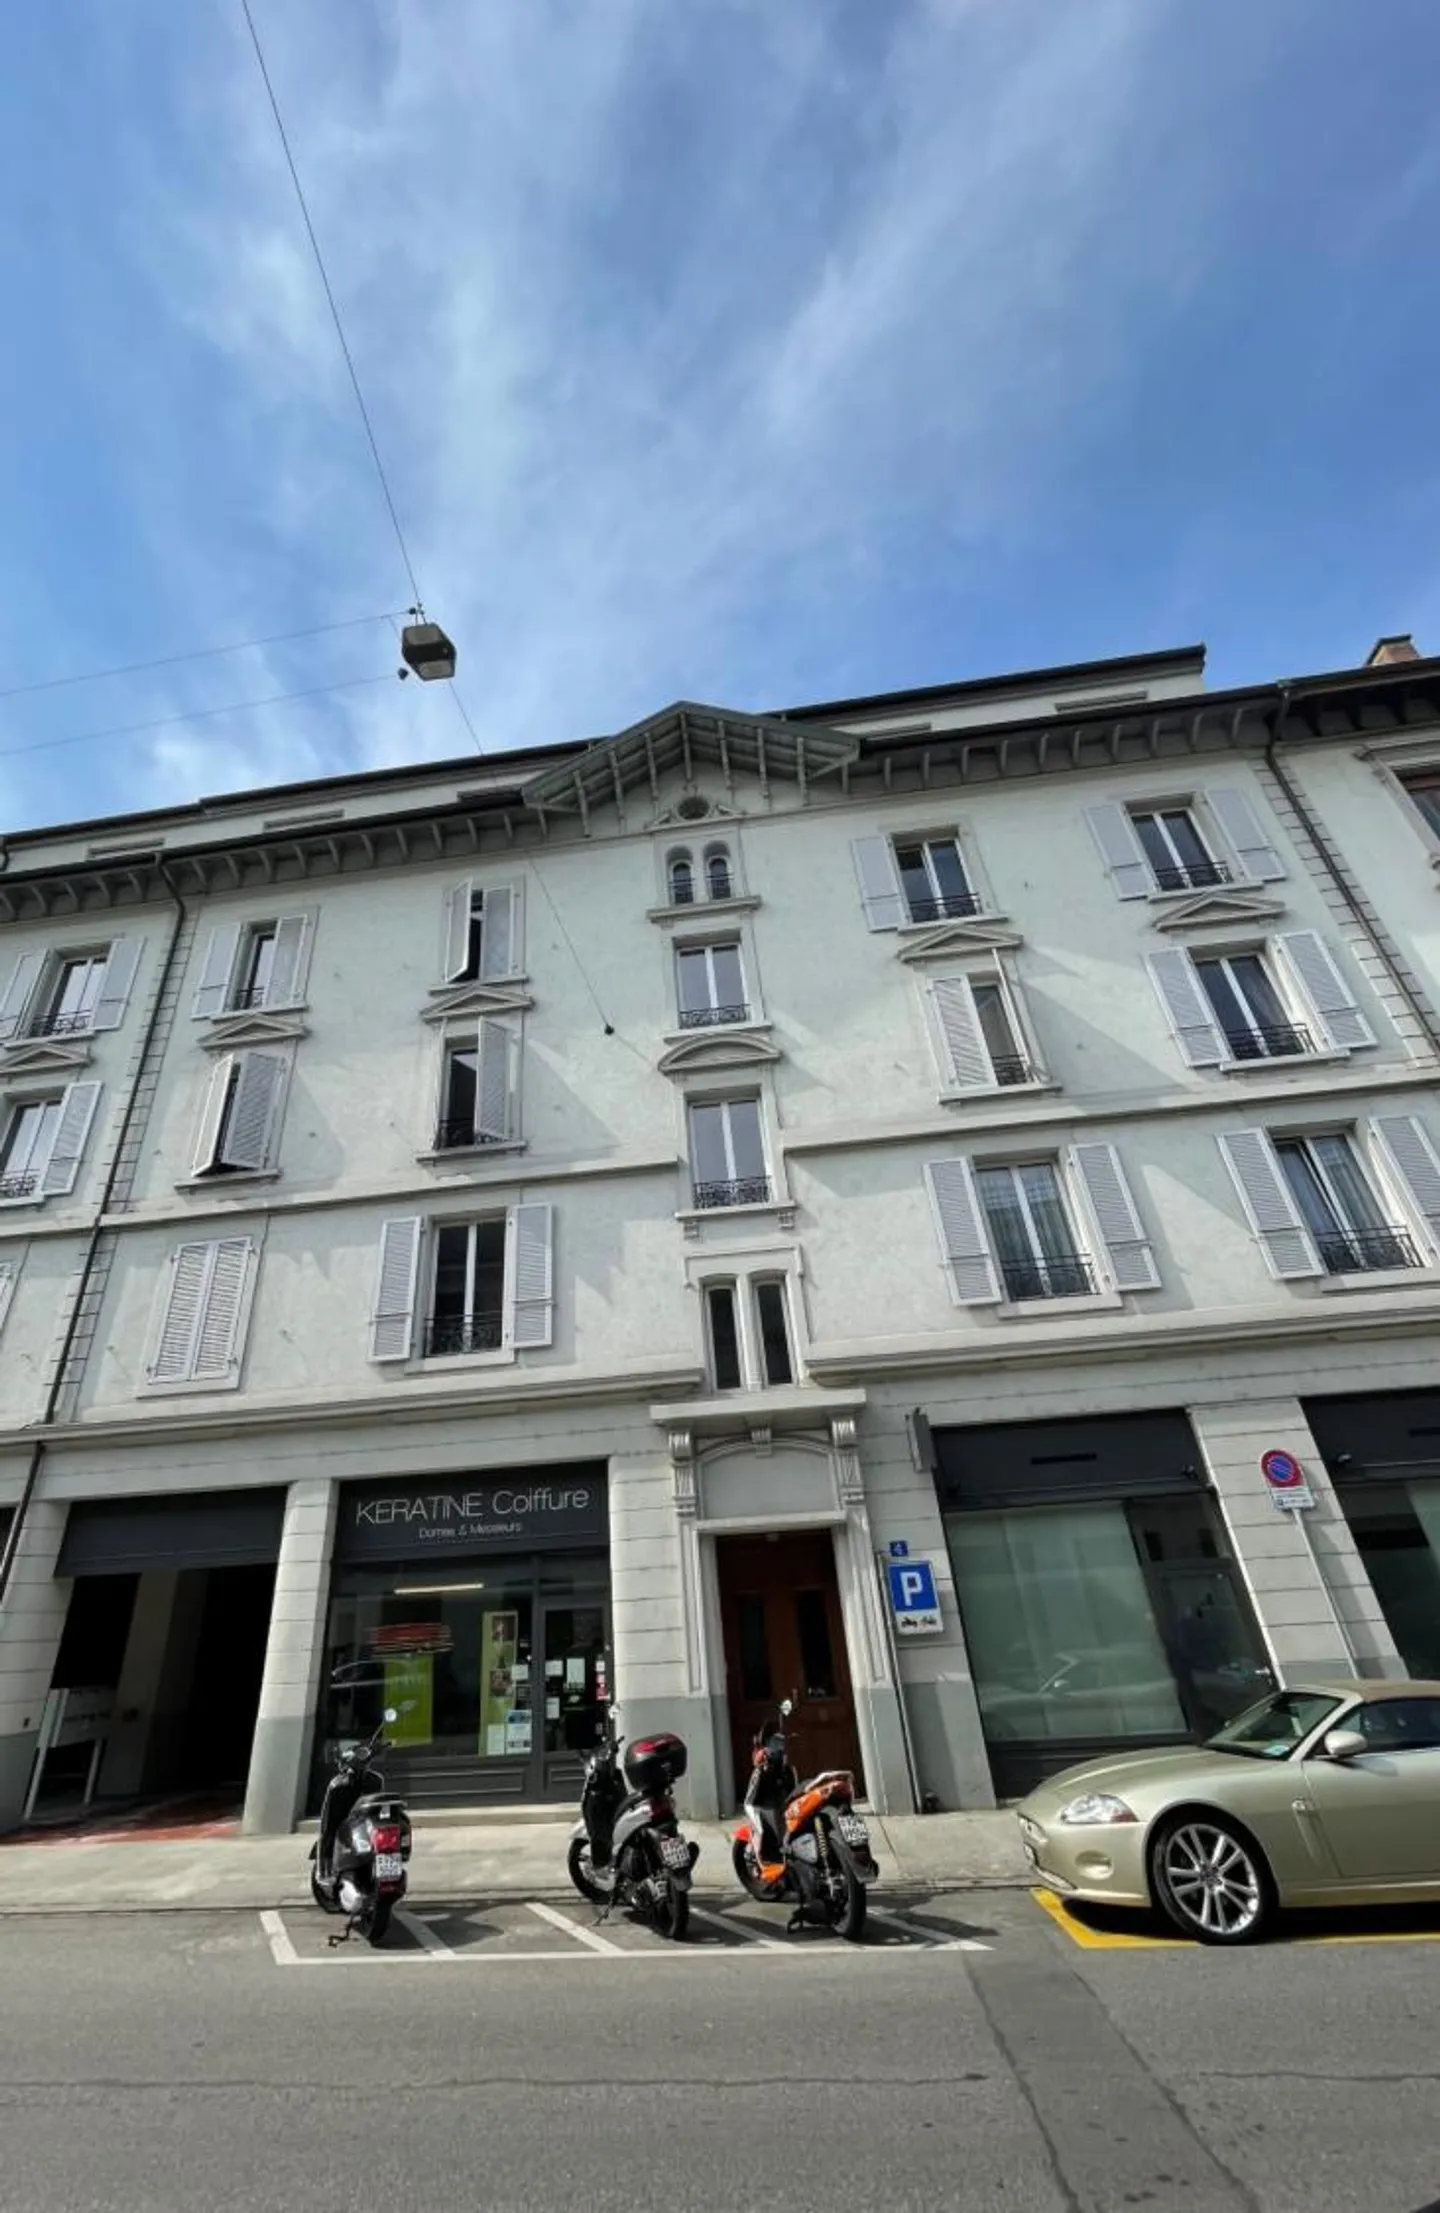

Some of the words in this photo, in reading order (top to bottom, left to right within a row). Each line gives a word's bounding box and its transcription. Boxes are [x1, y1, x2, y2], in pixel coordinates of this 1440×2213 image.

[356, 1492, 484, 1525] KERATINE
[492, 1487, 590, 1515] Coiffure
[458, 1524, 468, 1536] &
[900, 1571, 923, 1607] P
